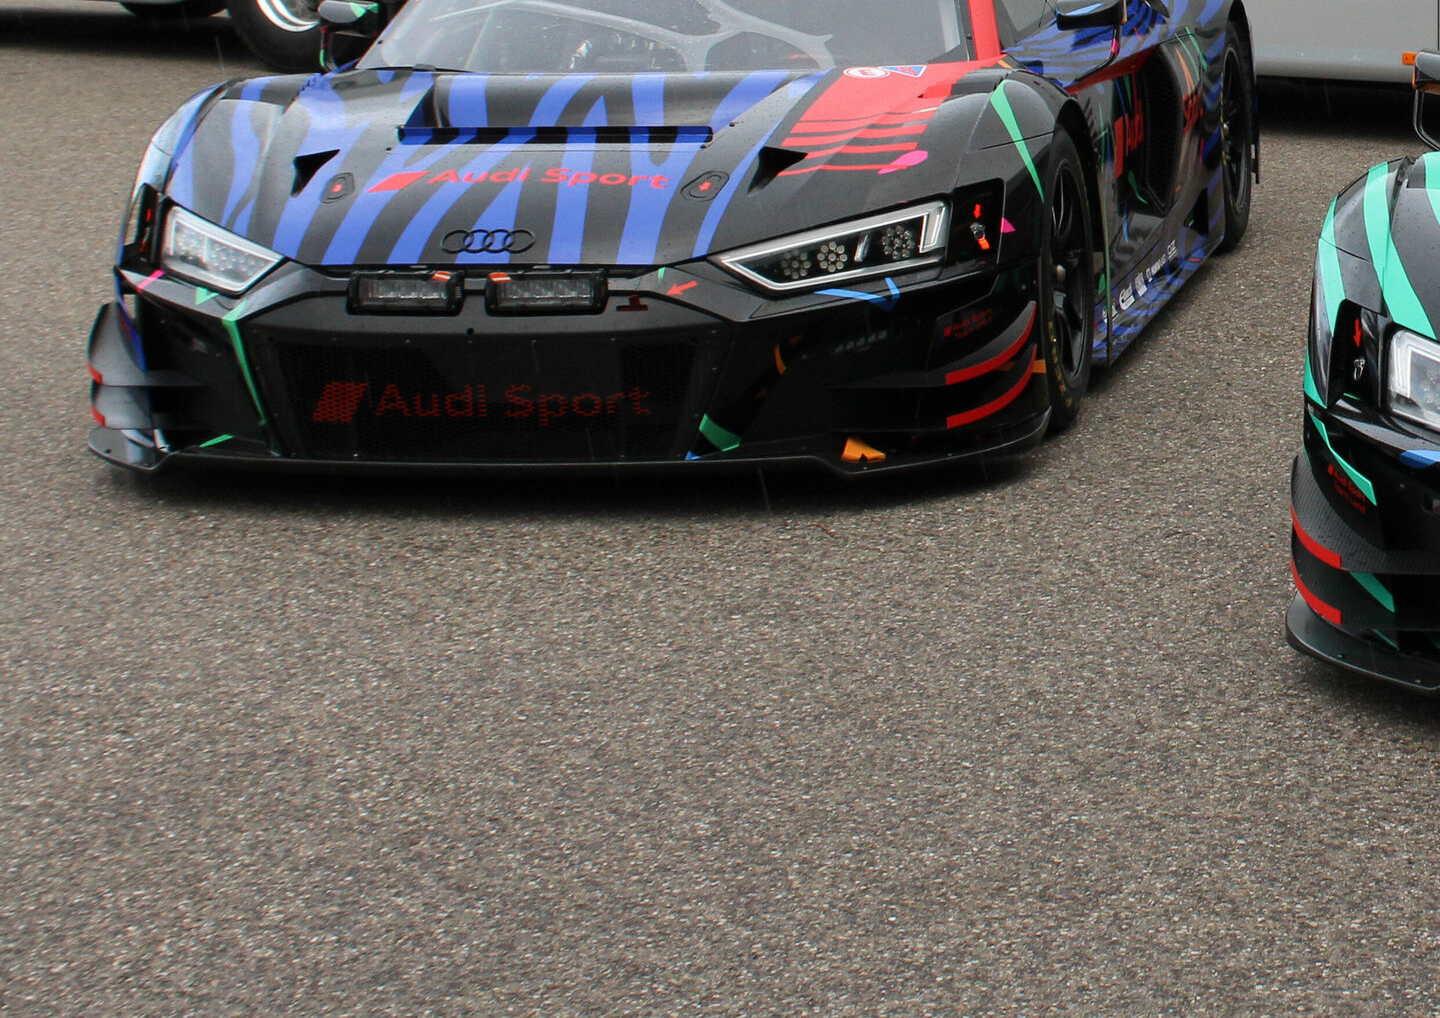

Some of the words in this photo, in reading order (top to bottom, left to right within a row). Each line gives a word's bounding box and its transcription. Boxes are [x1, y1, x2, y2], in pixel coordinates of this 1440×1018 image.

[427, 168, 531, 184] Audi
[541, 168, 670, 189] Sport
[375, 384, 488, 417] Audi
[504, 384, 651, 427] Sport
